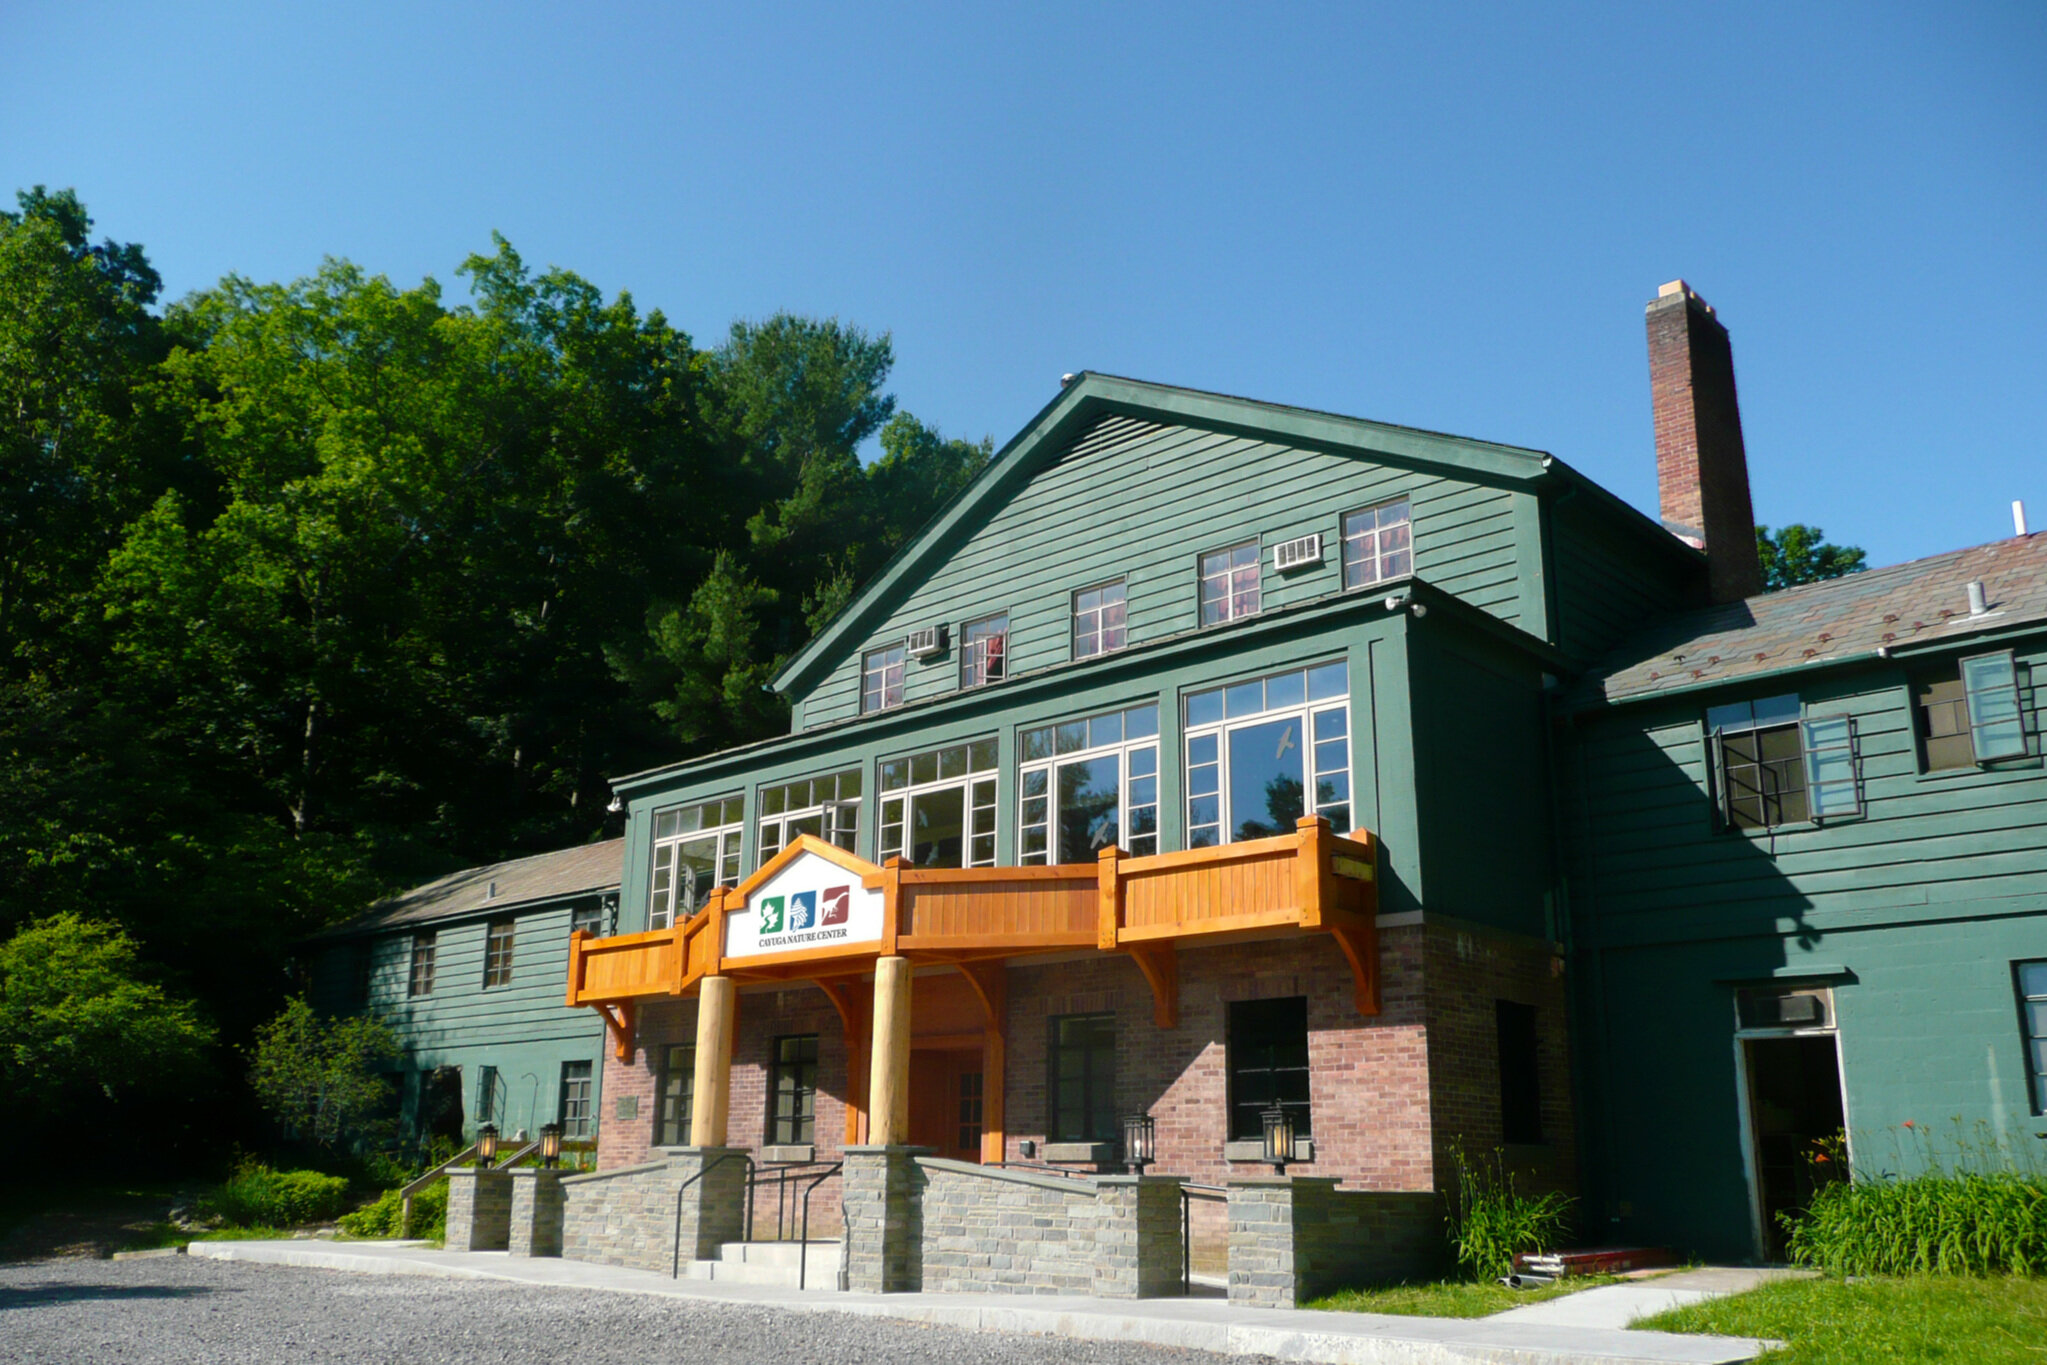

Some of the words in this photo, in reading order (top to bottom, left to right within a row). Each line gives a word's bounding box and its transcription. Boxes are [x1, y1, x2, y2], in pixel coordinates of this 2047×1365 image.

[759, 936, 786, 948] CAYUGA
[787, 932, 816, 944] NATURE
[817, 928, 847, 940] CENTER
